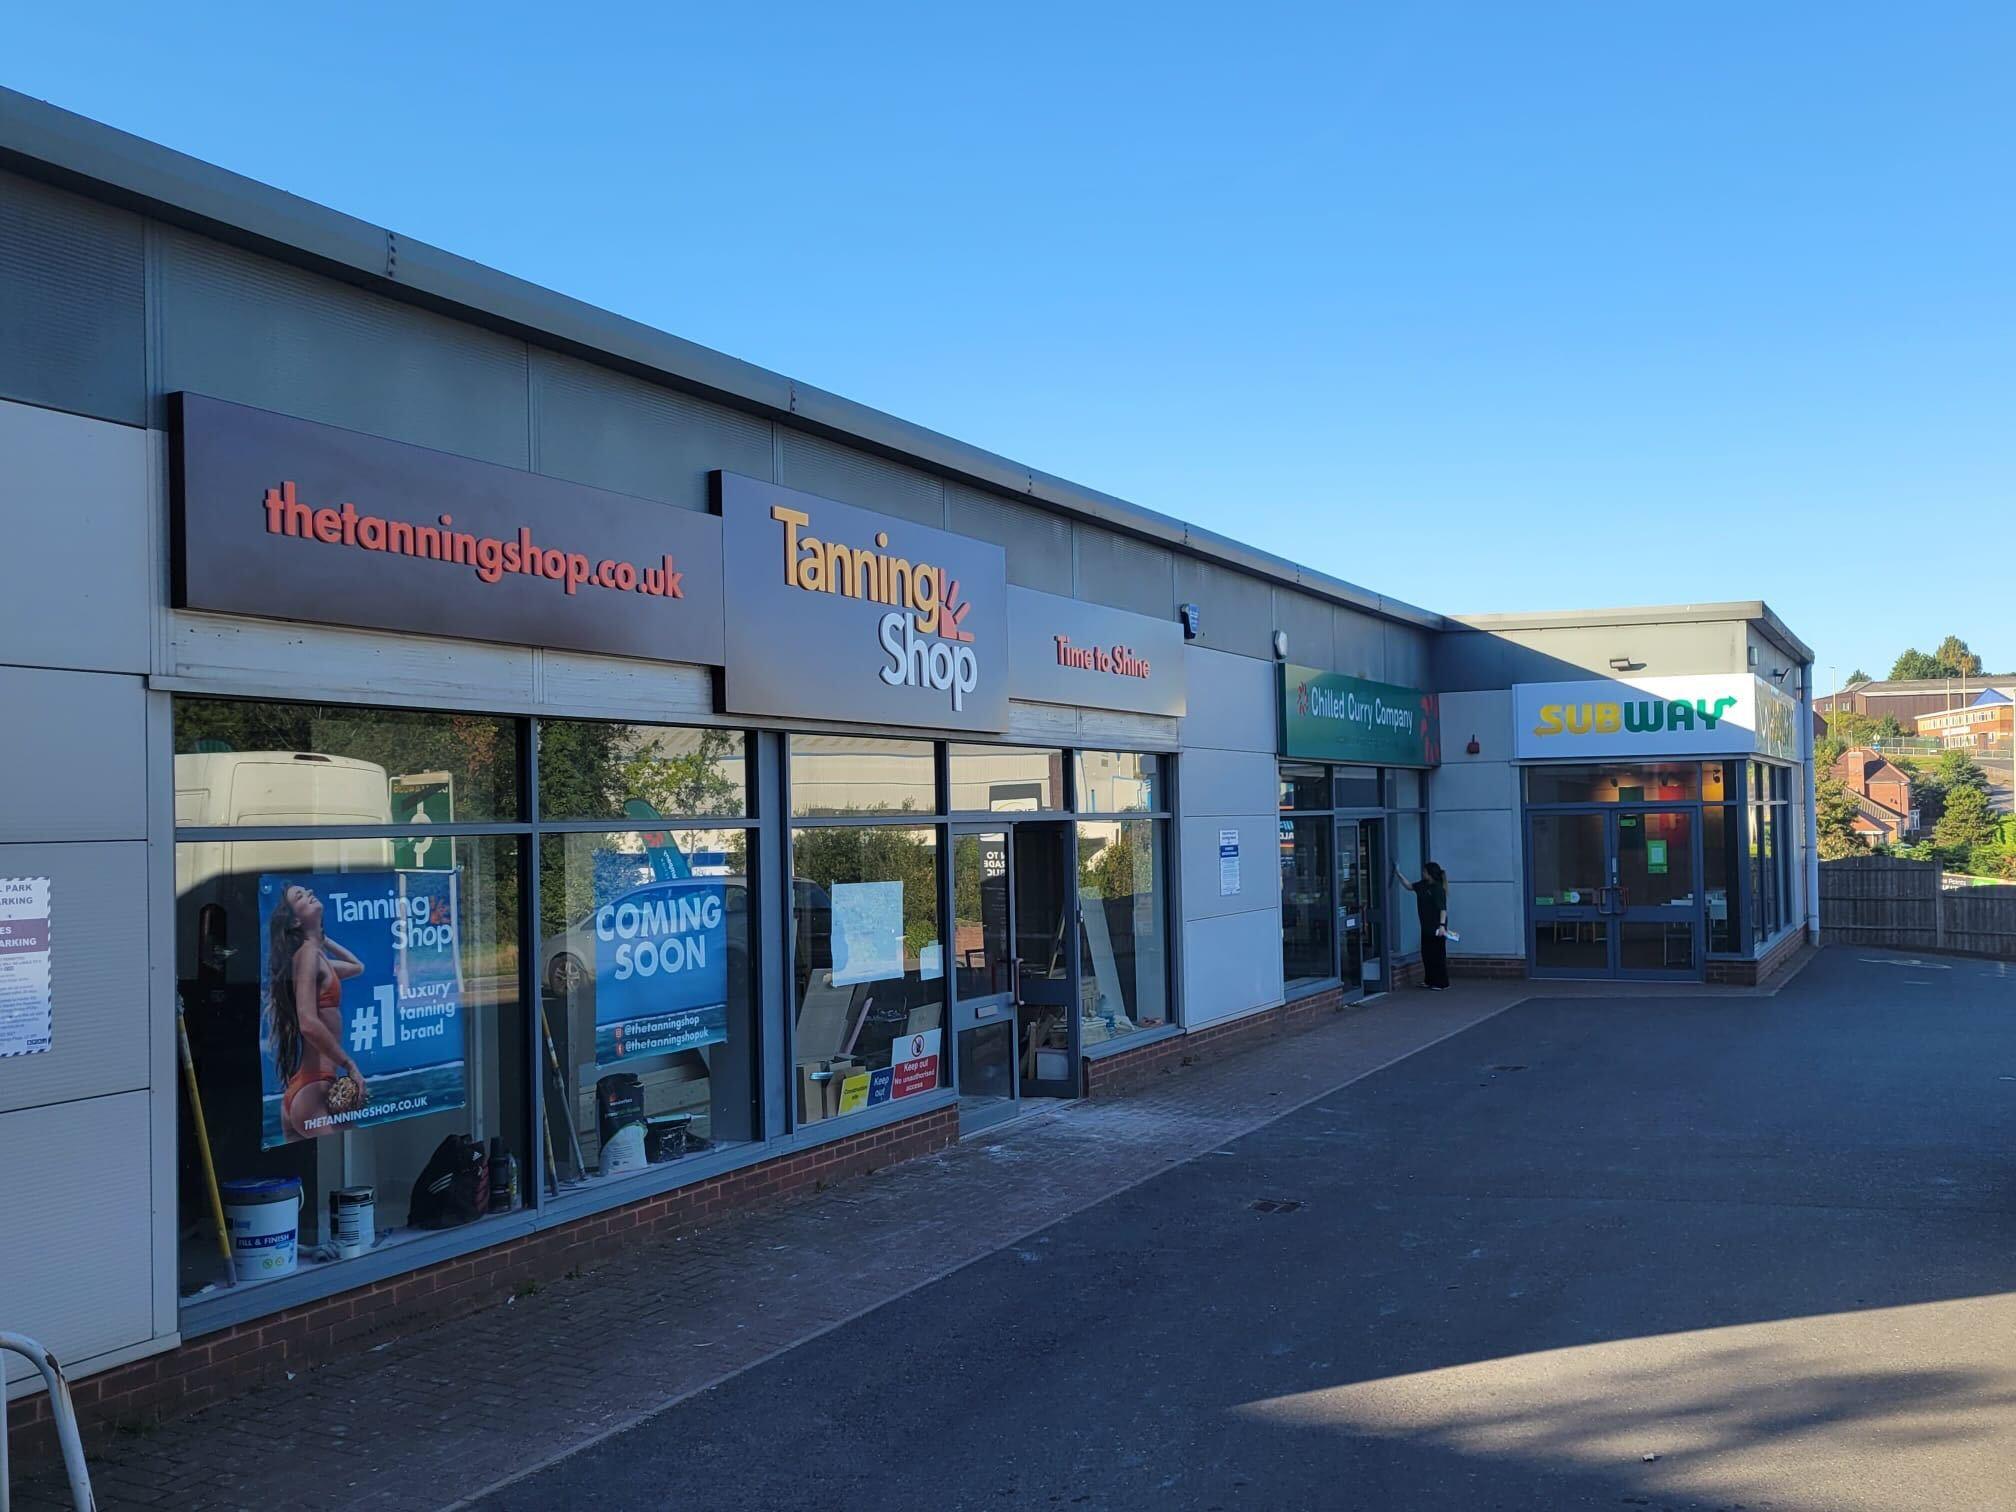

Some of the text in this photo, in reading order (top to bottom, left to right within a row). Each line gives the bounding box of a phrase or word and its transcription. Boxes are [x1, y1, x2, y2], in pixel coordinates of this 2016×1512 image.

[264, 481, 685, 598] thetanningshop.co.uk
[770, 505, 940, 634] Tanning
[879, 612, 978, 712] Shop
[1053, 635, 1151, 679] Time to Shine
[1311, 686, 1413, 735] Chilled Curry Company
[1534, 696, 1738, 737] SUBWAY
[0, 897, 33, 905] RKING
[6, 884, 32, 893] PARK
[328, 889, 431, 925] Tanning
[596, 895, 722, 942] COMING
[390, 918, 454, 953] Shop
[614, 934, 706, 981] SOON
[400, 982, 451, 1000] Luxury
[350, 984, 396, 1052] #1
[400, 1000, 456, 1021] tanning
[624, 1015, 700, 1036] @thetanningshop
[400, 1019, 444, 1042] brand
[624, 1026, 710, 1052] @thetanningshopuk
[873, 1075, 890, 1086] Keep
[904, 1062, 918, 1072] Keep
[303, 1095, 429, 1131] THETANNINGSHOP.CO.UK
